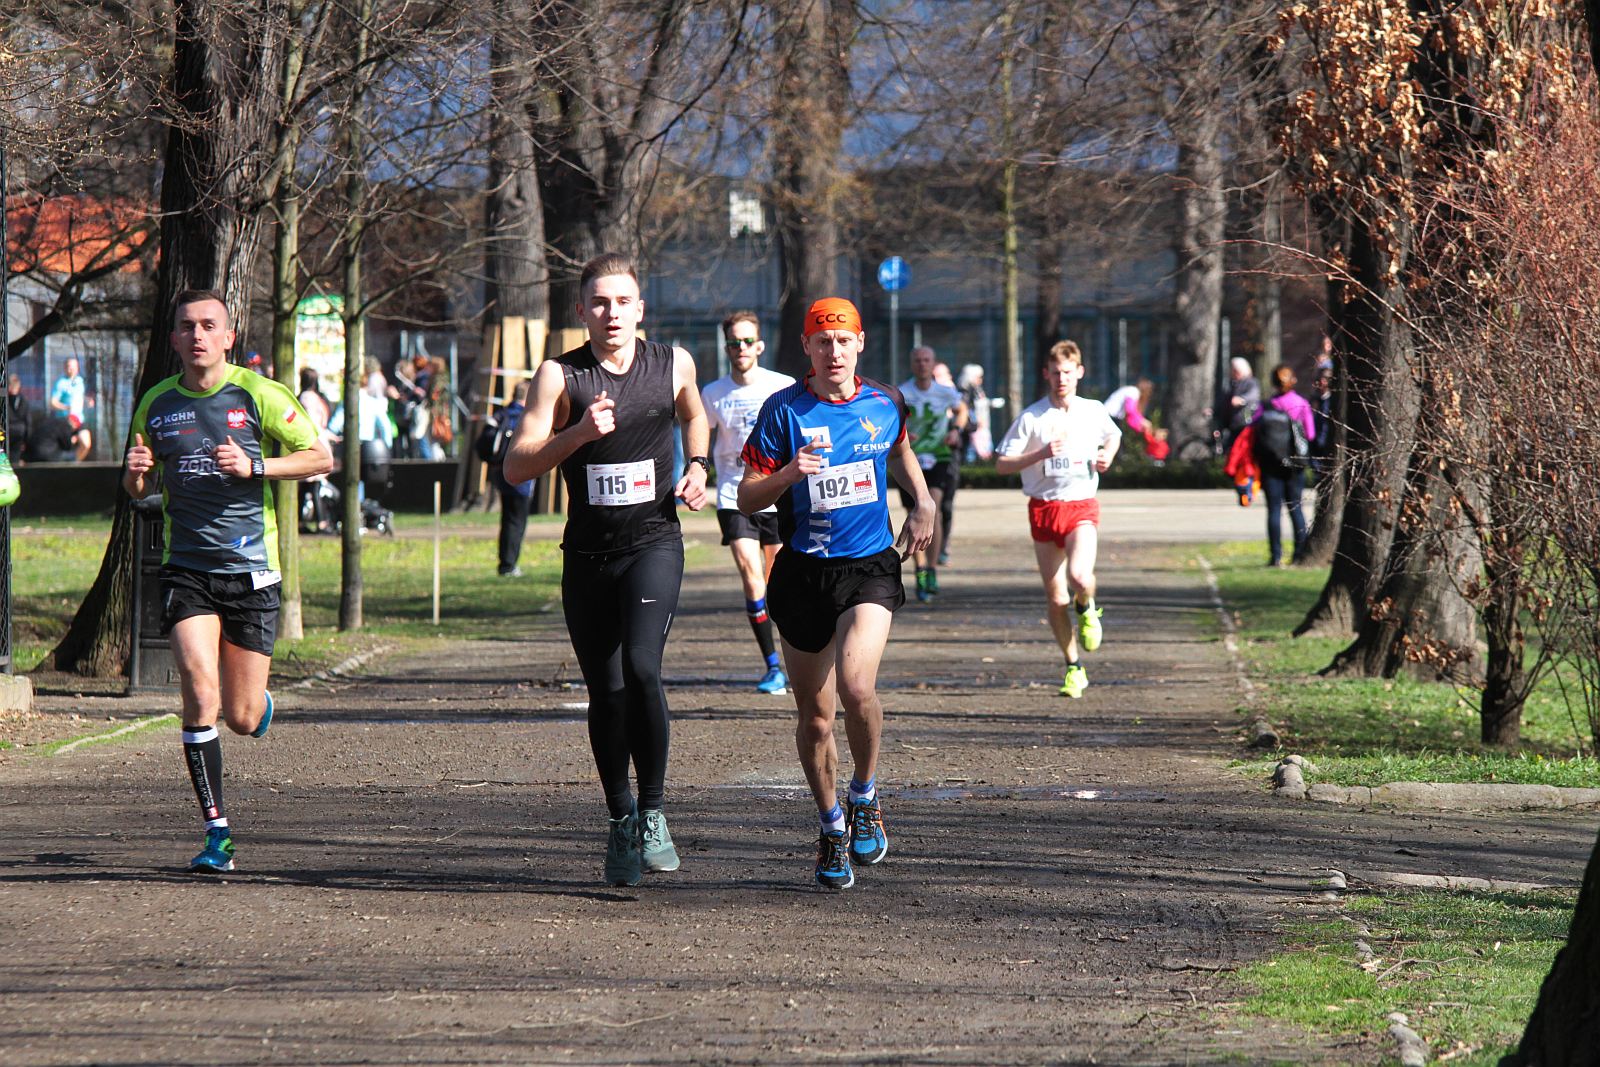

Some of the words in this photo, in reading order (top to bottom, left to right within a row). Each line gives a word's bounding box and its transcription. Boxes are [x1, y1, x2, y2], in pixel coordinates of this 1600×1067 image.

[815, 313, 847, 325] CCC
[164, 411, 196, 423] KGHM
[1049, 457, 1070, 470] 160
[595, 474, 627, 495] 115
[815, 476, 850, 500] 192
